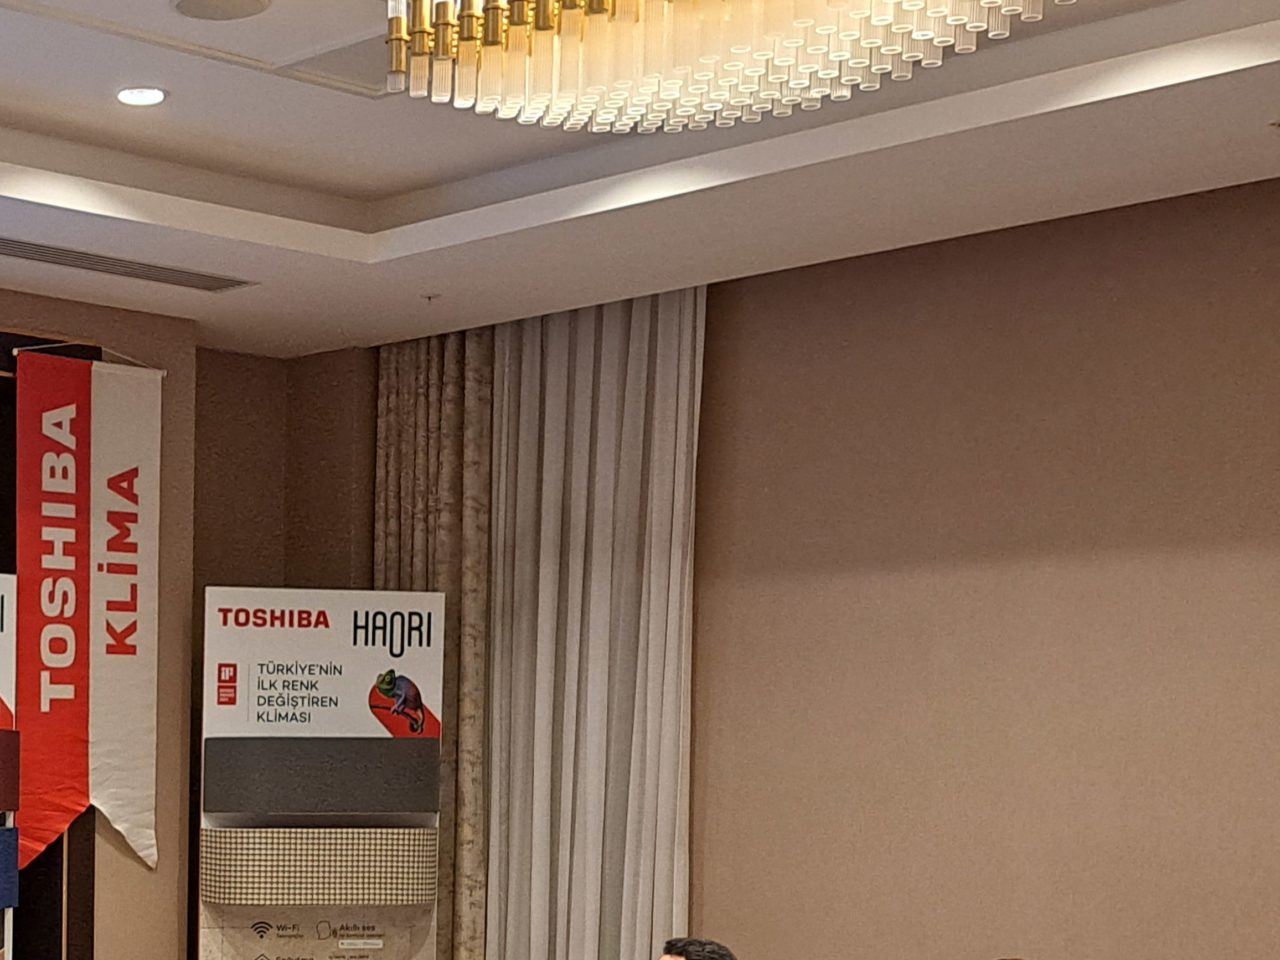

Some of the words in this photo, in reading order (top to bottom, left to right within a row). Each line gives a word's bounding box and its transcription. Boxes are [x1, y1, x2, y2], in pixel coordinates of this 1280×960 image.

[40, 403, 77, 712] TOSHIBA
[97, 467, 140, 656] KLİMA
[218, 608, 330, 628] TOSHIBA
[353, 610, 432, 658] HAORI
[257, 661, 343, 675] TÜRKİYE'NİN
[257, 677, 276, 690] İLK
[282, 680, 318, 691] RENK
[257, 693, 338, 708] DEĞİŞTİREN
[257, 709, 311, 723] KLİMASI
